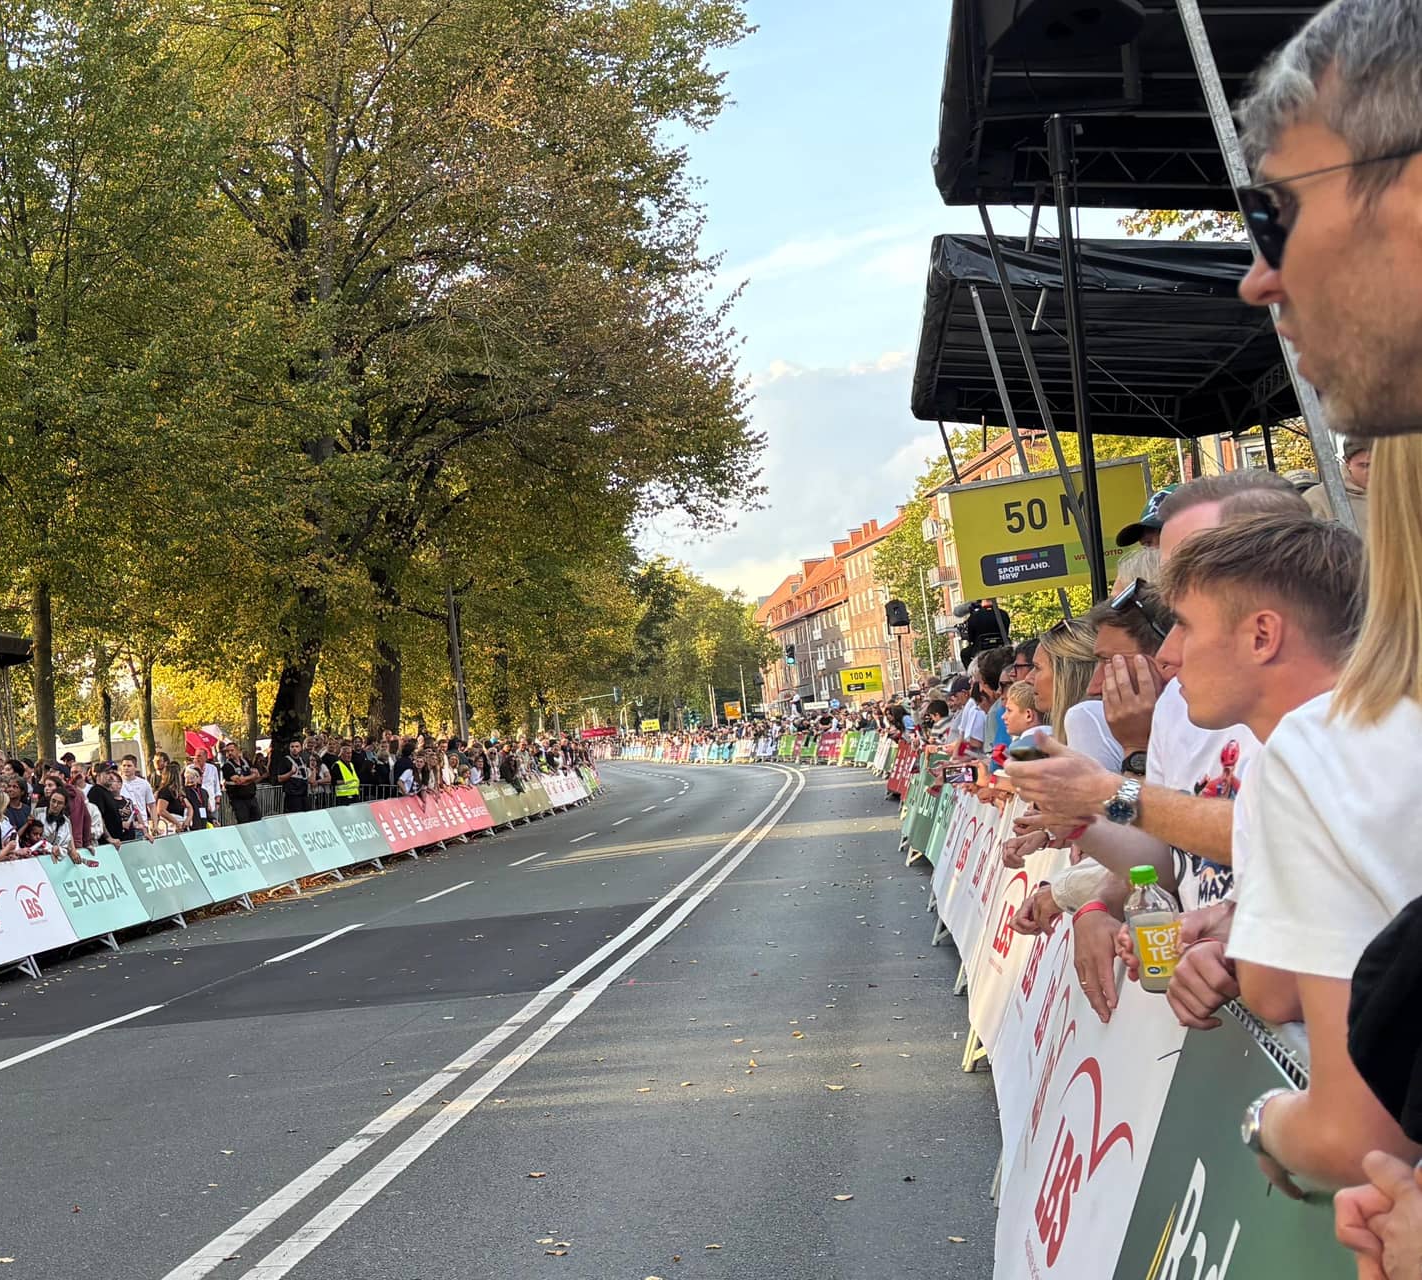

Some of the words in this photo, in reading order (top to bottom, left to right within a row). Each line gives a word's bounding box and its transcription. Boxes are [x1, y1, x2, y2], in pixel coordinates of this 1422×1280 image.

[1004, 498, 1048, 534] 50
[1060, 491, 1086, 526] M
[998, 572, 1019, 581] NRW
[850, 671, 864, 680] 100
[866, 671, 873, 679] M
[20, 897, 43, 919] LBS
[993, 901, 1015, 960] LBS
[1034, 1114, 1083, 1269] LBS
